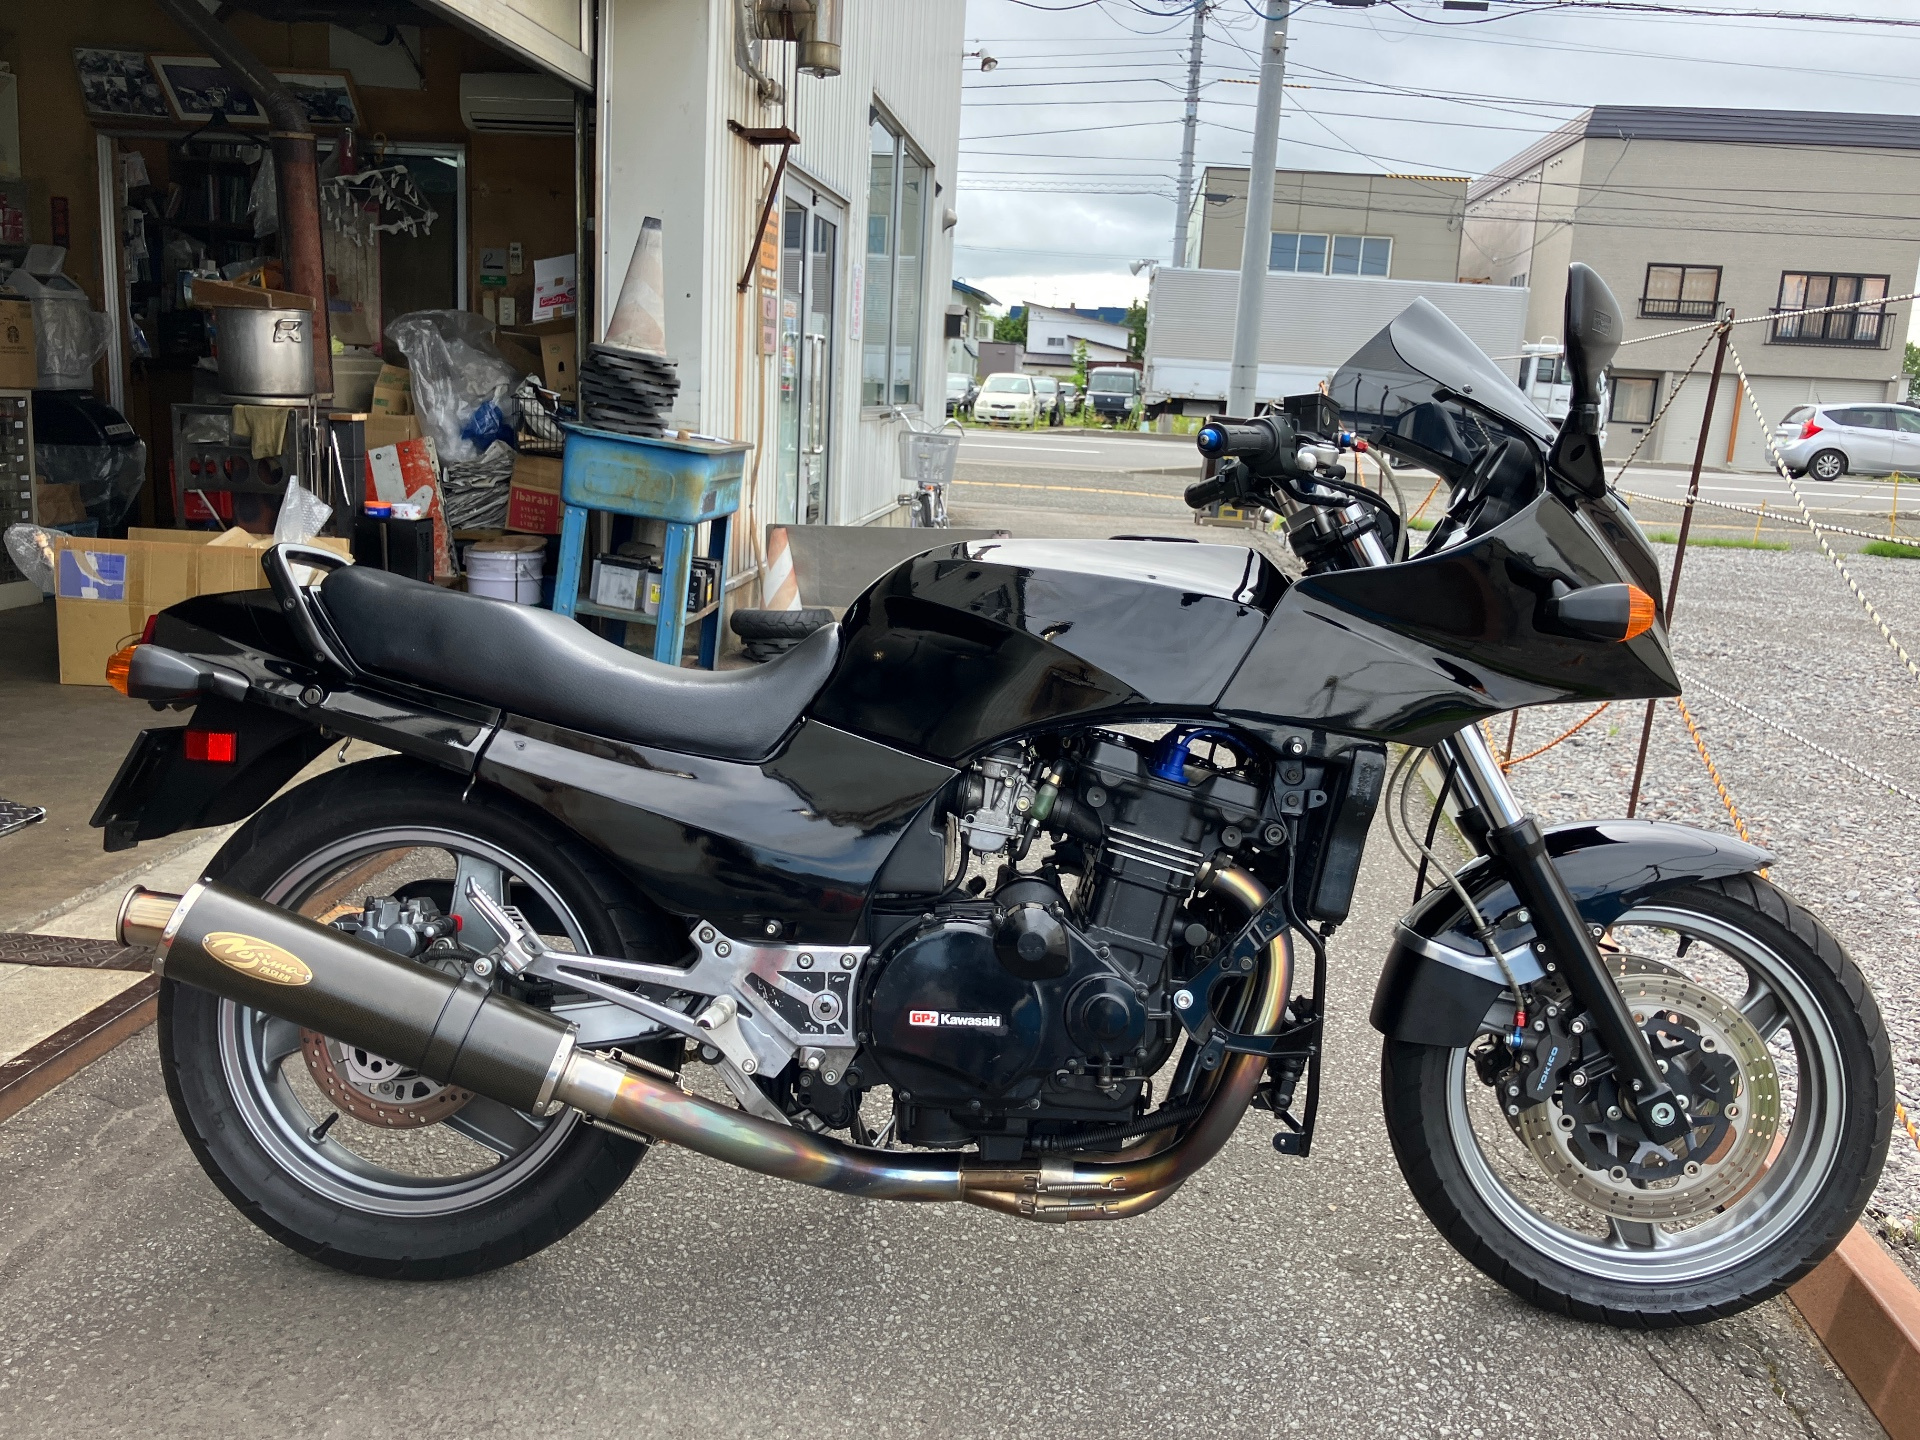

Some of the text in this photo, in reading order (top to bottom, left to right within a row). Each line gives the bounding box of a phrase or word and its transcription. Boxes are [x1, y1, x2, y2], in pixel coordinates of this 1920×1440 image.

[515, 490, 554, 507] Ibaraki
[940, 1013, 1001, 1027] Kawasaki
[1536, 1046, 1559, 1091] TOKICO
